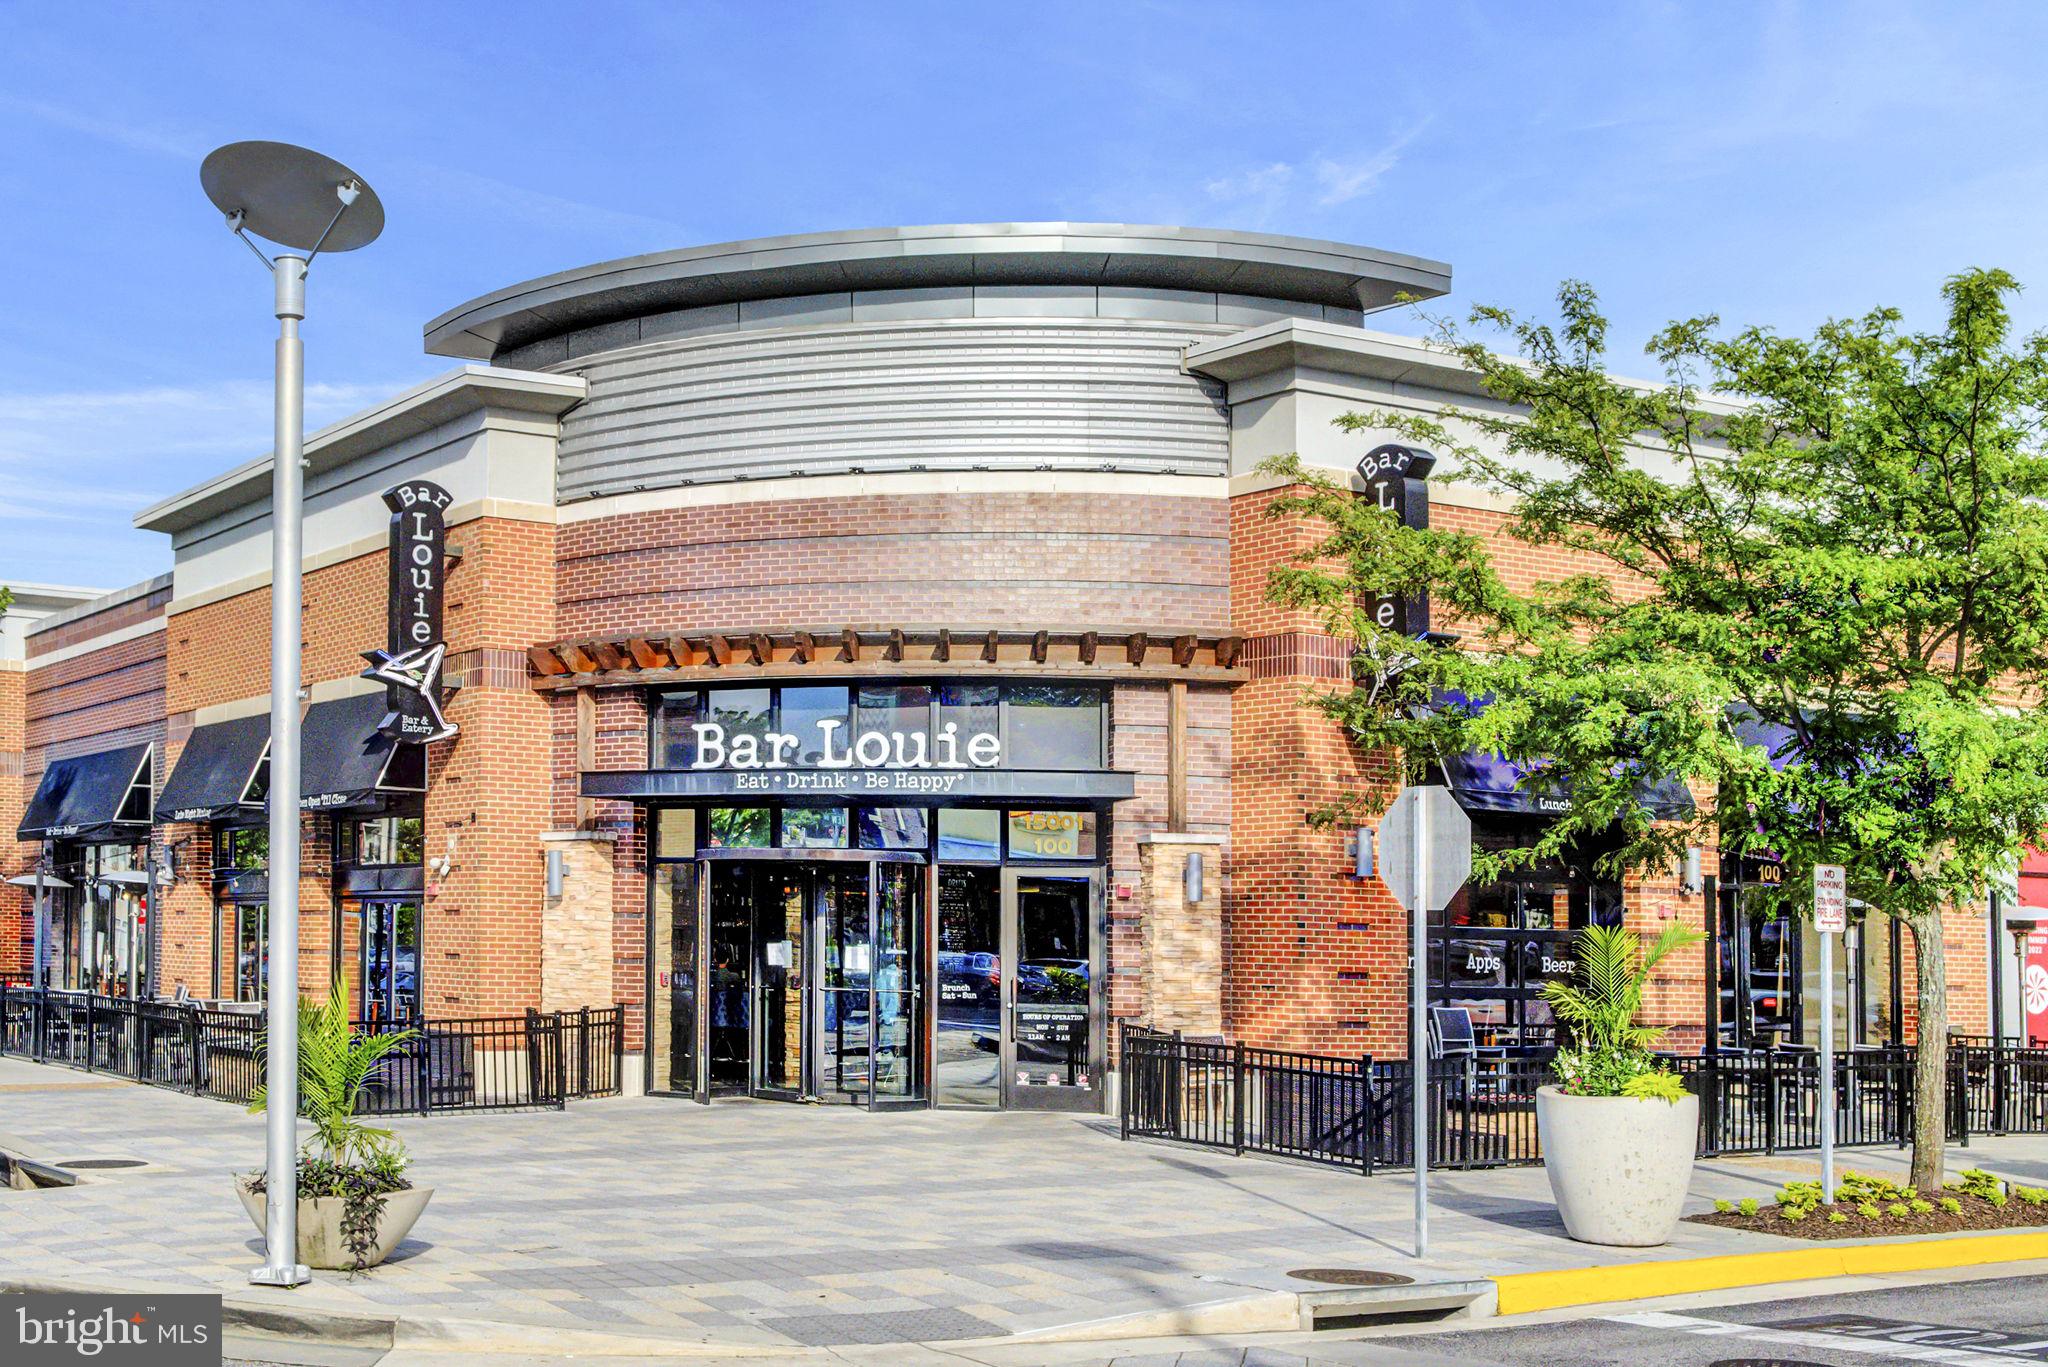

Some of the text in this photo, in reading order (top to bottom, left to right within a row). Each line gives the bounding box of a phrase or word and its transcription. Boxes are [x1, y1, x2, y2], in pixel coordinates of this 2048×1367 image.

[1360, 452, 1409, 480] Bar
[397, 485, 450, 509] Bar
[410, 511, 434, 643] Louie
[402, 714, 429, 725] Bar &
[402, 723, 434, 735] Eatery
[691, 719, 1001, 769] Bar Louie
[736, 773, 769, 789] Eat
[787, 773, 848, 789] Drink
[865, 774, 889, 788] Be
[1539, 798, 1572, 810] Lunch
[1024, 814, 1083, 831] 15001
[1035, 837, 1072, 854] 100
[1758, 864, 1781, 882] 100
[1824, 869, 1835, 879] NO
[1817, 880, 1843, 889] PARKING
[1830, 908, 1843, 919] LANE
[1466, 953, 1500, 973] Apps
[1541, 956, 1575, 973] Beer
[941, 983, 971, 992] Brunch
[941, 992, 956, 1000] Sat
[962, 991, 977, 999] Sun
